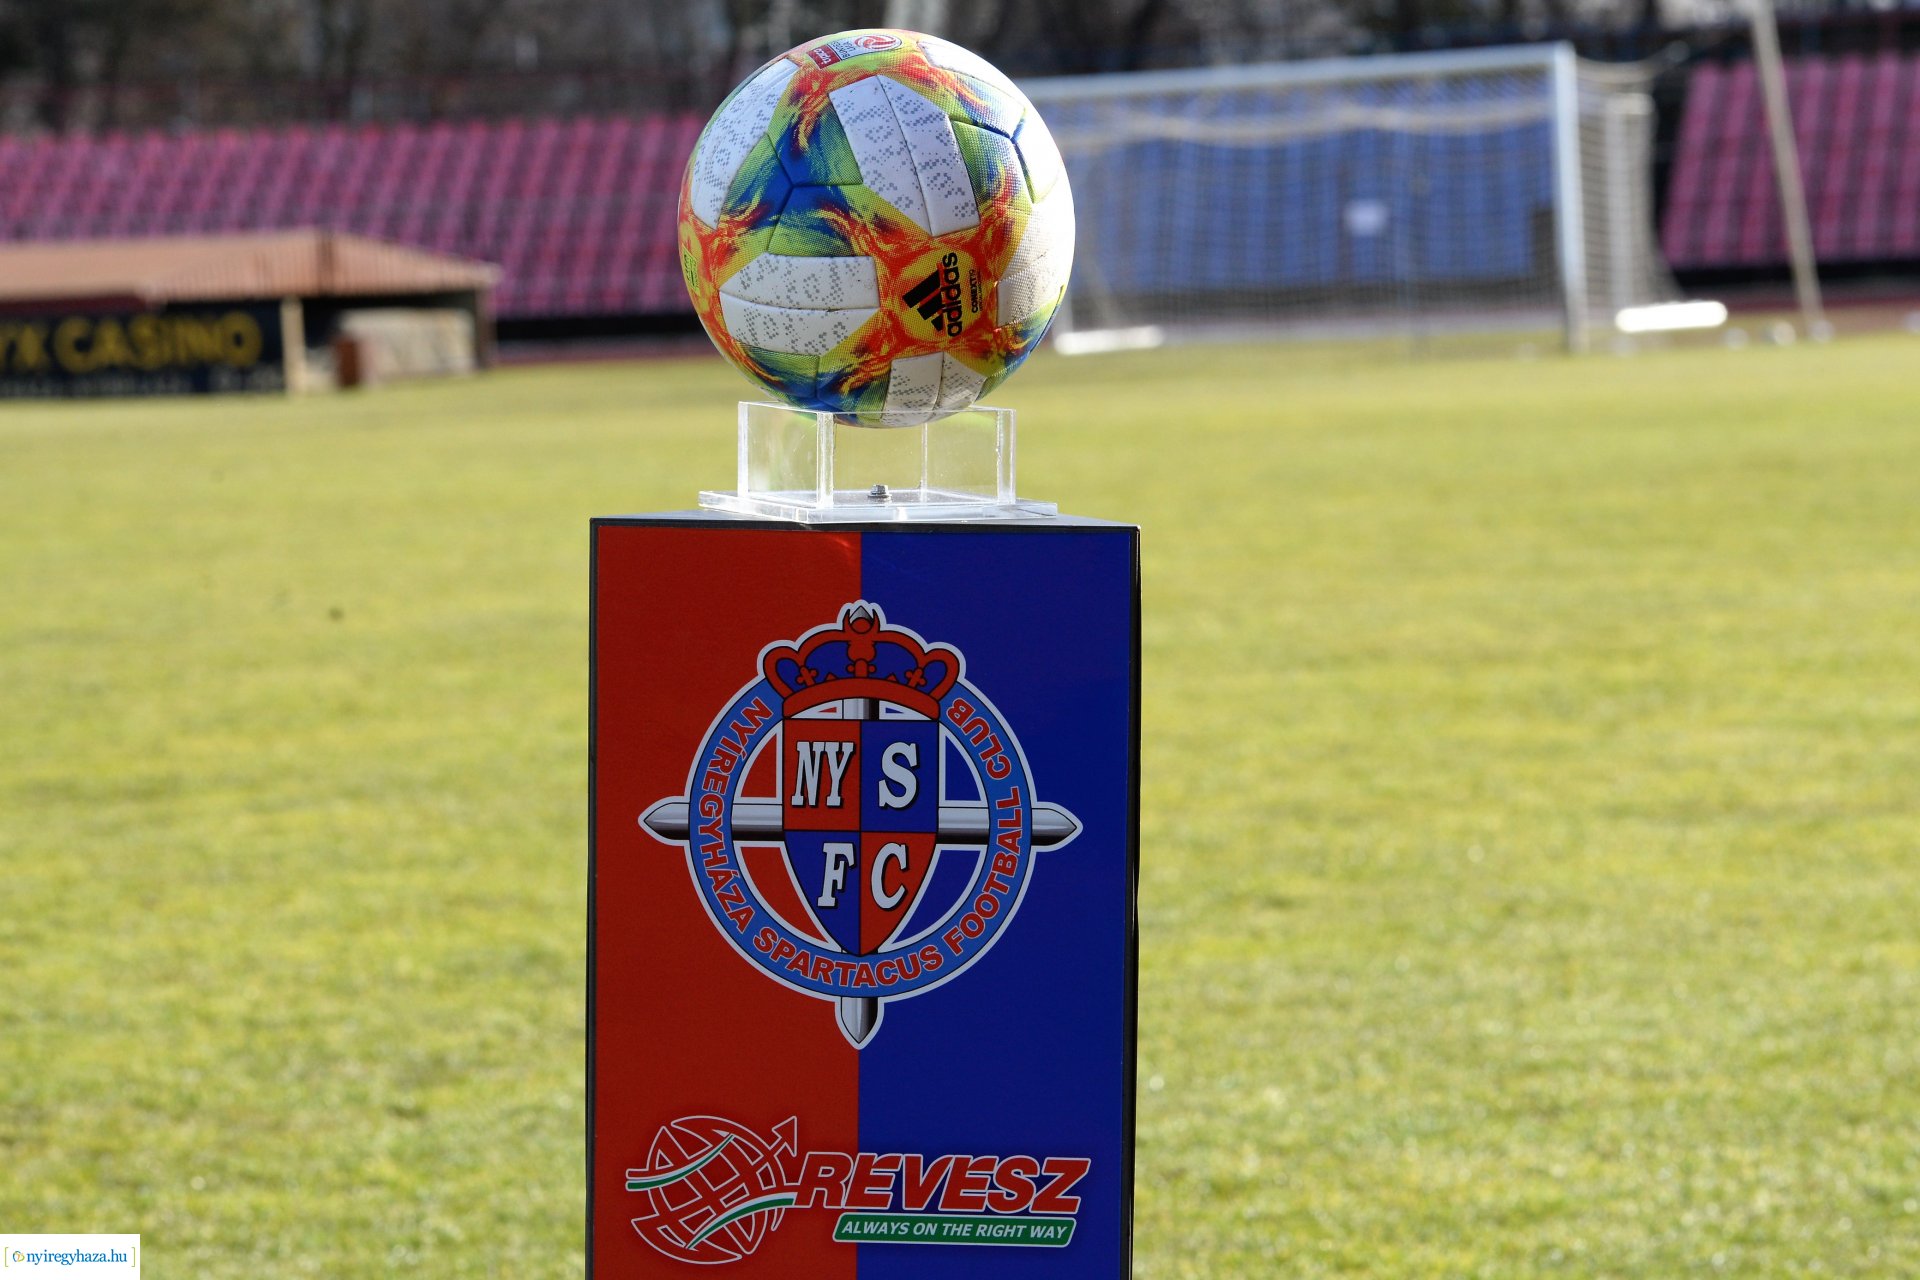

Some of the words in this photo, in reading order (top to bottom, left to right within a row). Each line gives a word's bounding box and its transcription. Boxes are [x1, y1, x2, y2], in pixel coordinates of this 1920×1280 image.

[942, 252, 962, 337] adidas
[53, 311, 263, 374] CASINO
[947, 697, 1012, 779] CLUB
[790, 741, 855, 808] NY
[878, 741, 920, 809] S
[696, 697, 774, 933] NYÍREGYHÁZA
[817, 842, 855, 908] F
[871, 842, 910, 909] C
[942, 786, 1023, 955] FOOTBALL
[752, 926, 944, 988] SPARTACUS
[794, 1151, 1091, 1214] REVESZ
[841, 1221, 909, 1236] ALWAYS
[912, 1223, 938, 1237] ON
[940, 1223, 972, 1237] THE
[975, 1224, 1026, 1239] RIGHT
[1029, 1225, 1068, 1240] WAY
